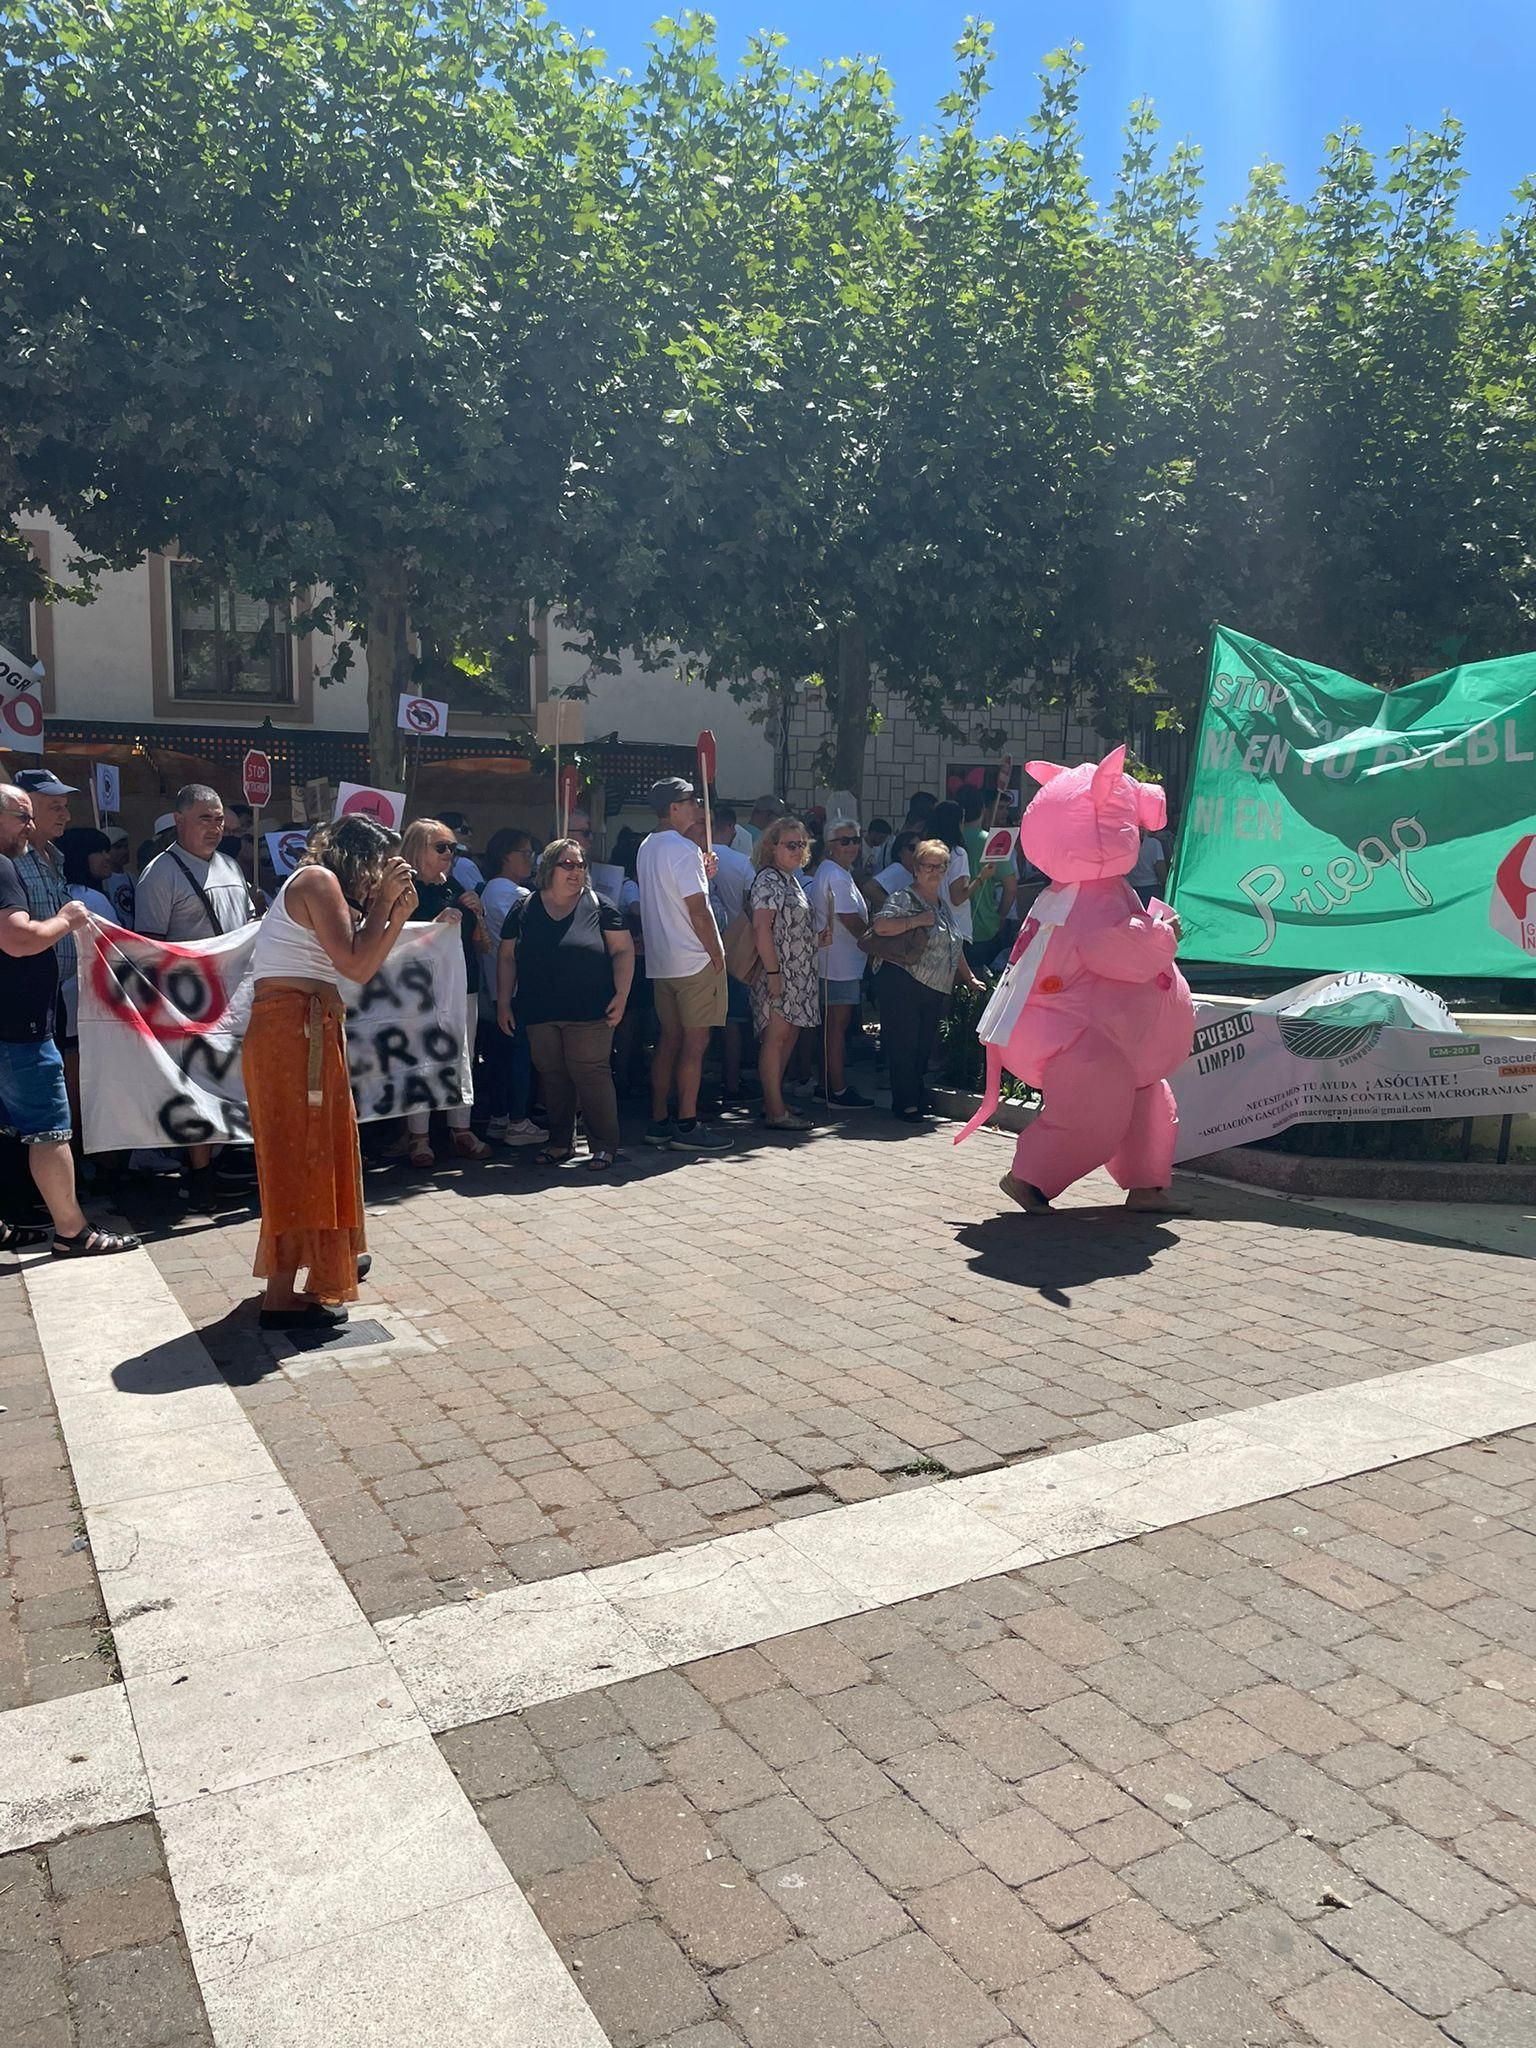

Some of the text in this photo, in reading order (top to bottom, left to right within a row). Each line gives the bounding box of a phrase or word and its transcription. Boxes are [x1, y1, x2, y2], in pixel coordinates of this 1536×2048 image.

[1210, 673, 1288, 714] STOP
[1202, 728, 1236, 769] NI
[1242, 734, 1290, 774] EN
[248, 764, 266, 778] STOP
[1193, 796, 1282, 841] NI EN
[1231, 811, 1434, 957] Priego
[112, 958, 206, 1015] NO
[1197, 1012, 1252, 1050] PUEBLO
[1197, 1043, 1246, 1075] LIMPIO
[1433, 1046, 1477, 1056] CM-2017
[1302, 1082, 1317, 1092] TU
[1320, 1081, 1357, 1090] AYUDA
[1302, 1093, 1348, 1103] TINAJAS
[1351, 1092, 1400, 1102] CONTRA
[1403, 1091, 1425, 1100] LAS
